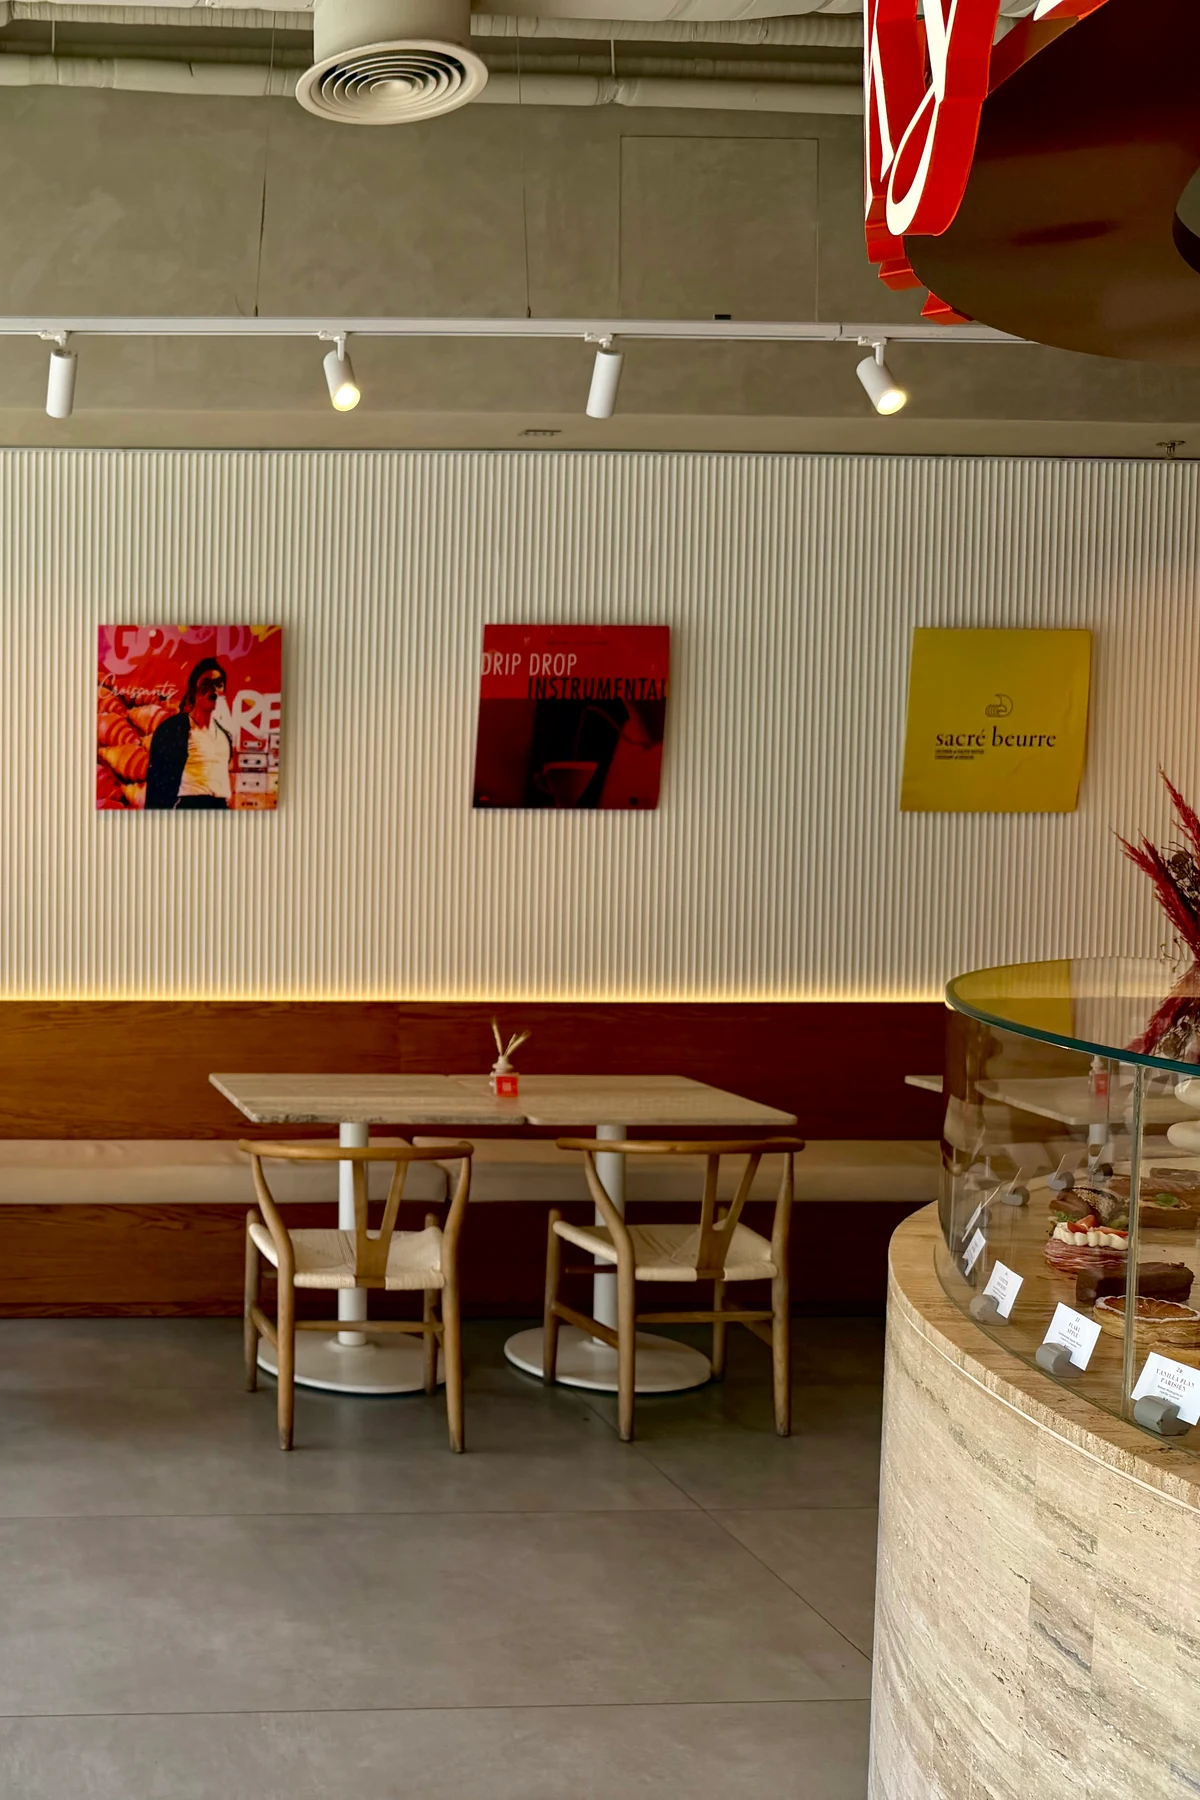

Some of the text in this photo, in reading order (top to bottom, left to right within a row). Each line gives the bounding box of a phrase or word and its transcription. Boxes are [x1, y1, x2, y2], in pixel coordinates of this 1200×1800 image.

[481, 652, 578, 677] DRIP DROP
[98, 672, 179, 700] Croissants
[935, 725, 1057, 748] sacré beurre
